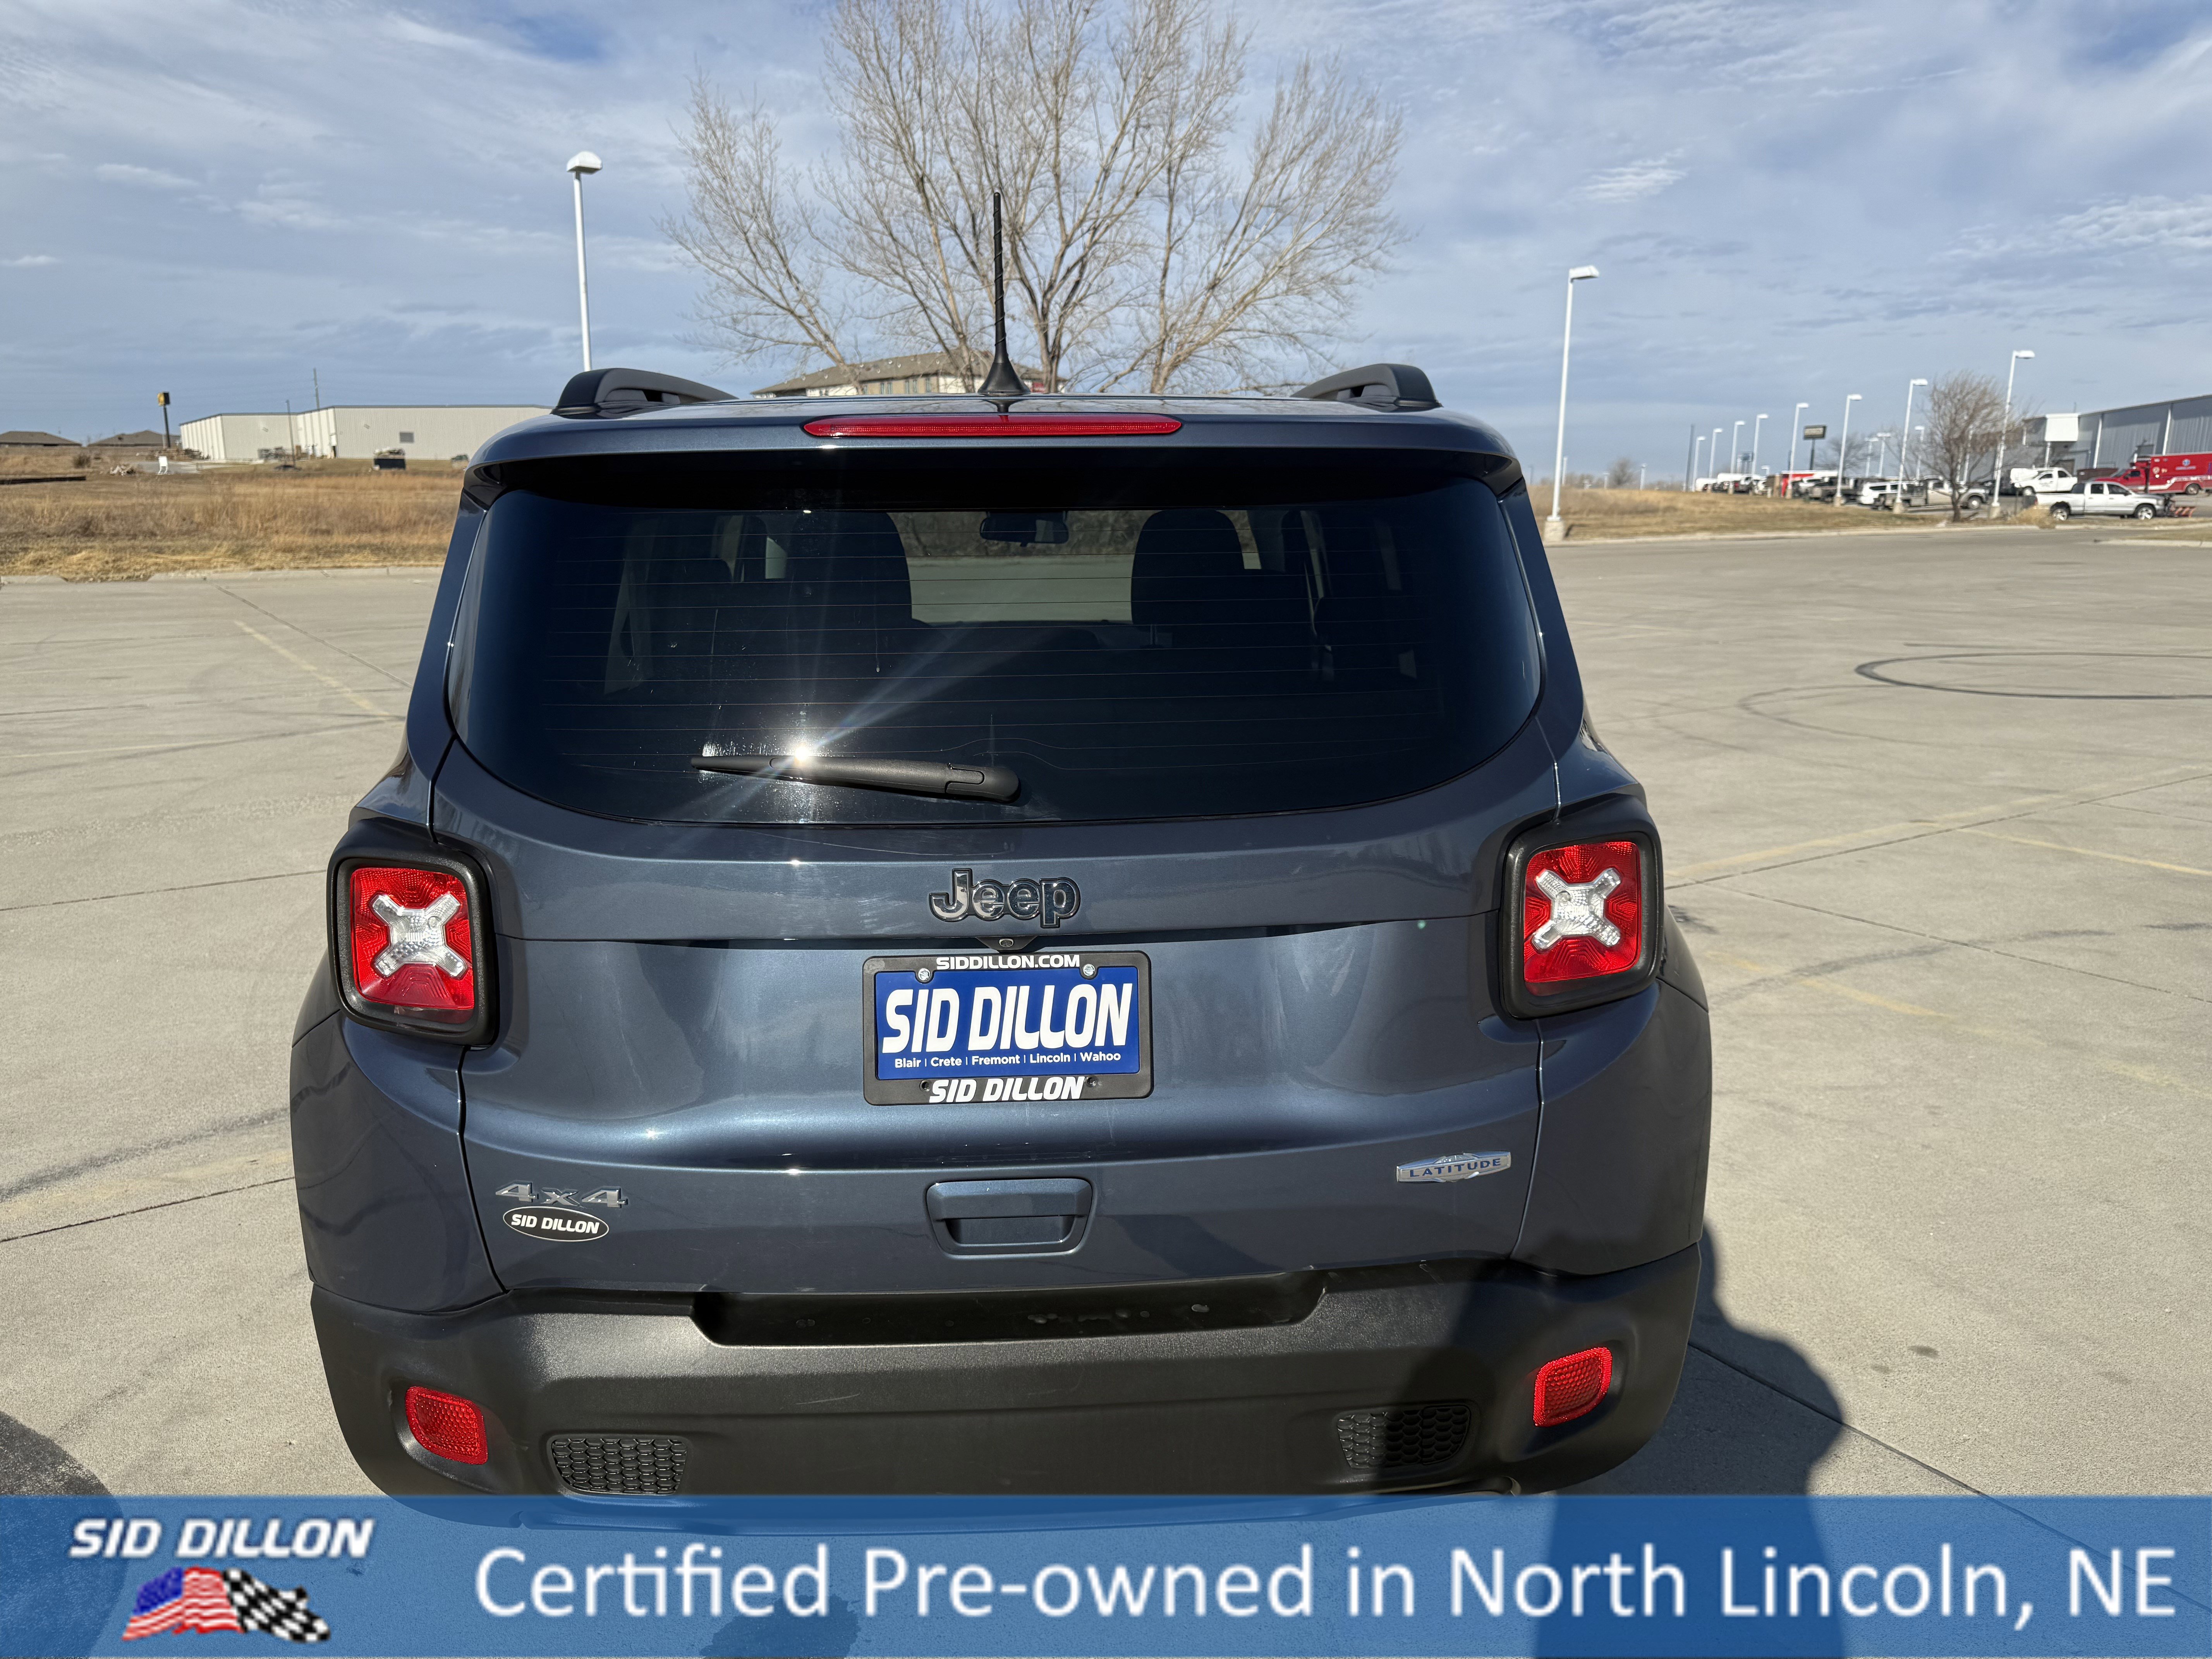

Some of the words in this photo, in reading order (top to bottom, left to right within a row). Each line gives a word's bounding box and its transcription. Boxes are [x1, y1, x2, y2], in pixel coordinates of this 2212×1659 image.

[929, 868, 1080, 929] Jeep
[936, 954, 1080, 970] SIDDILLON.COM
[882, 988, 960, 1054] SID
[967, 982, 1133, 1051] DILLON
[895, 1057, 922, 1068] Blair
[930, 1056, 962, 1067] Crete
[972, 1054, 1020, 1066] Fremont
[1030, 1052, 1071, 1064] Lincoln
[1080, 1051, 1121, 1062] Wahoo
[929, 1079, 977, 1103] SID
[982, 1076, 1085, 1101] DILLON
[1410, 1158, 1501, 1177] LATITUDE
[511, 1214, 537, 1228] SID
[541, 1217, 600, 1234] DILLON
